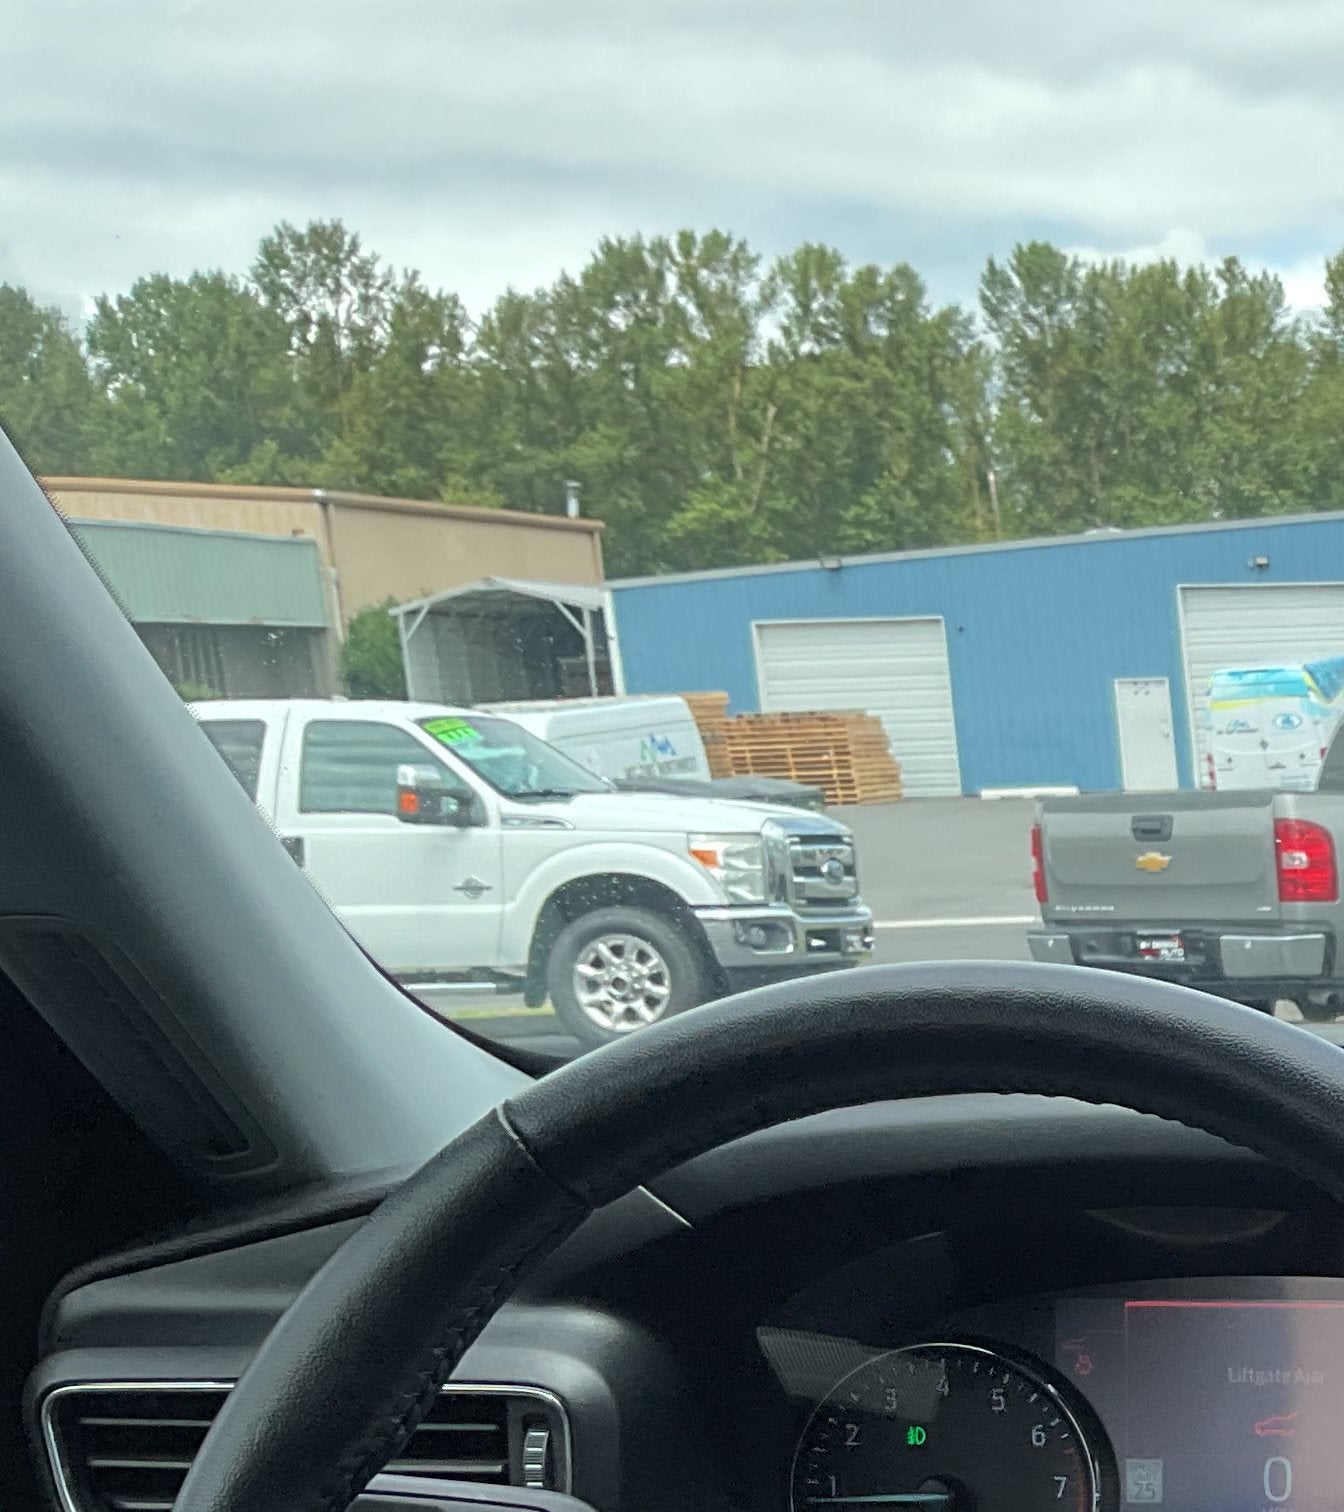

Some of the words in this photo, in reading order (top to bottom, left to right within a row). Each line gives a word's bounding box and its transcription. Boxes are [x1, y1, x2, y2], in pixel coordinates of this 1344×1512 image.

[936, 1376, 949, 1396] 4
[1227, 1366, 1290, 1385] Liftgate
[885, 1388, 898, 1411] 3
[992, 1388, 1006, 1411] 5
[846, 1423, 861, 1446] 2
[1031, 1424, 1046, 1448] 6
[828, 1476, 837, 1496] 1
[1054, 1476, 1067, 1498] 7
[1263, 1456, 1292, 1502] 0
[1134, 1482, 1156, 1499] 25
